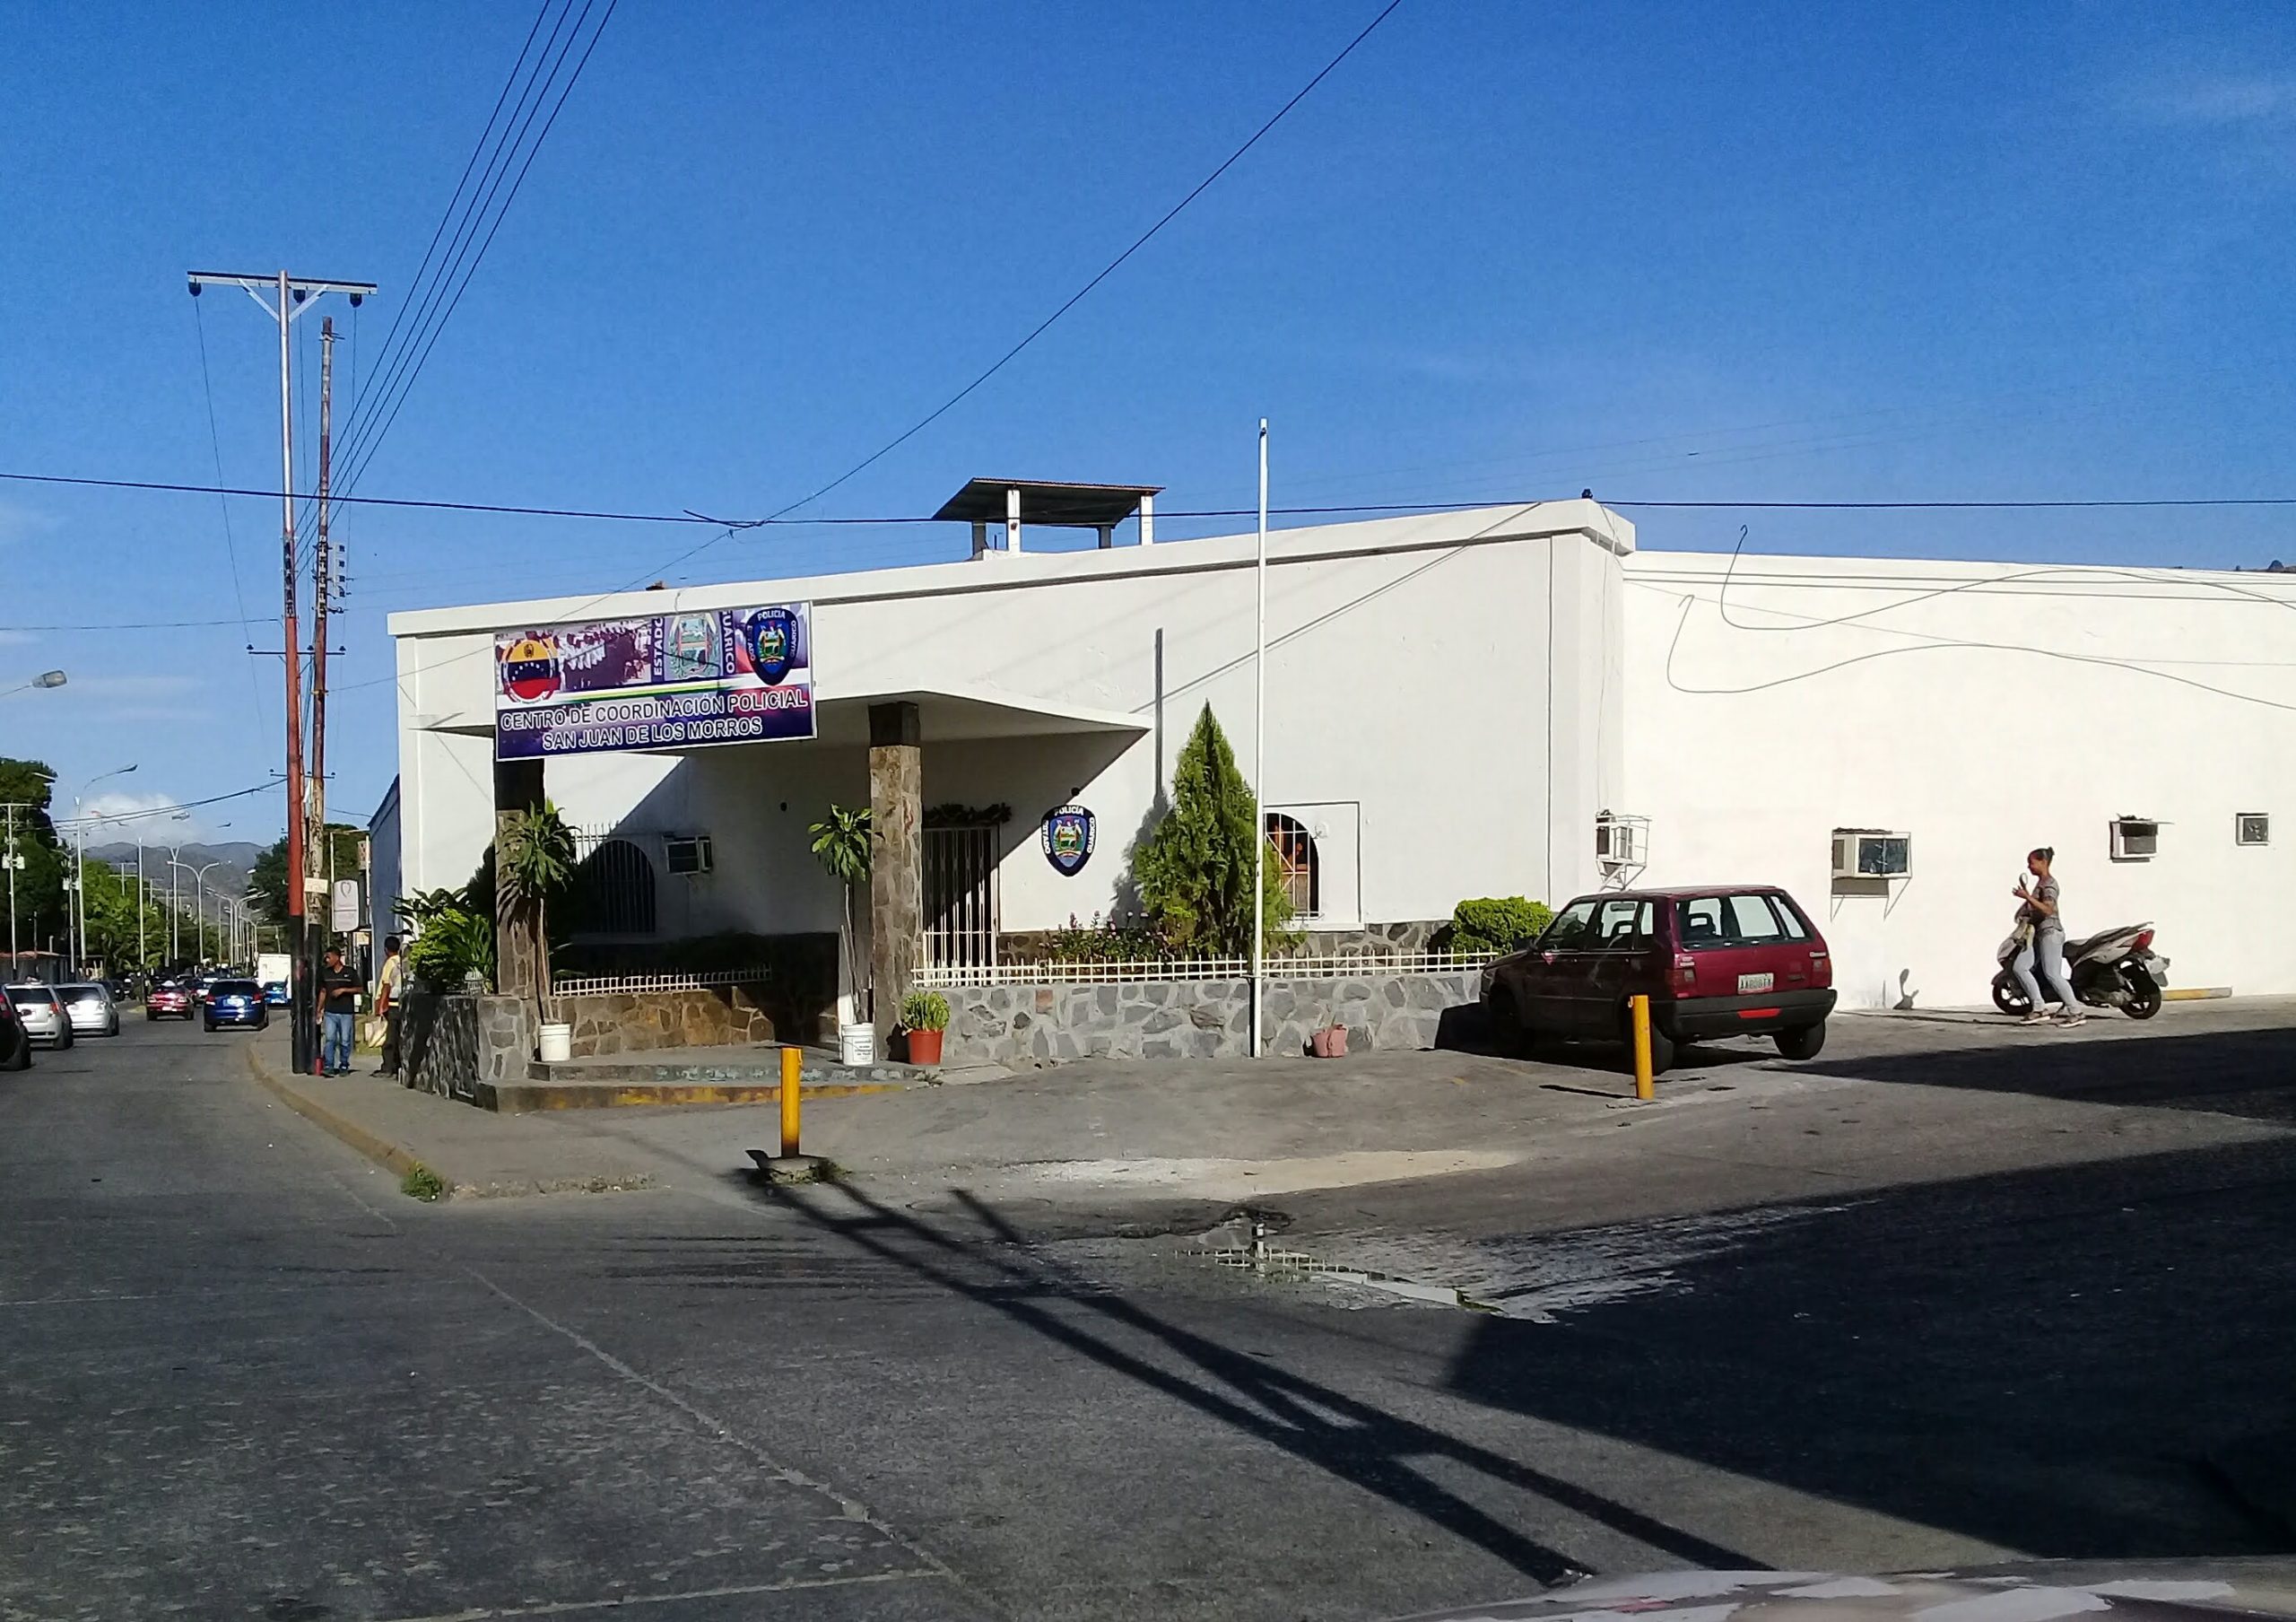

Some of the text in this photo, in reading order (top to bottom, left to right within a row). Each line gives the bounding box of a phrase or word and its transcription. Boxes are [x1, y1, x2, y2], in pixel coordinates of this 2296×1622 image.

[501, 710, 566, 730] CENTRO
[569, 707, 592, 725] DE
[728, 689, 808, 712] POLICIAL
[543, 717, 762, 750] SAN JUAN DE LOS MORROS
